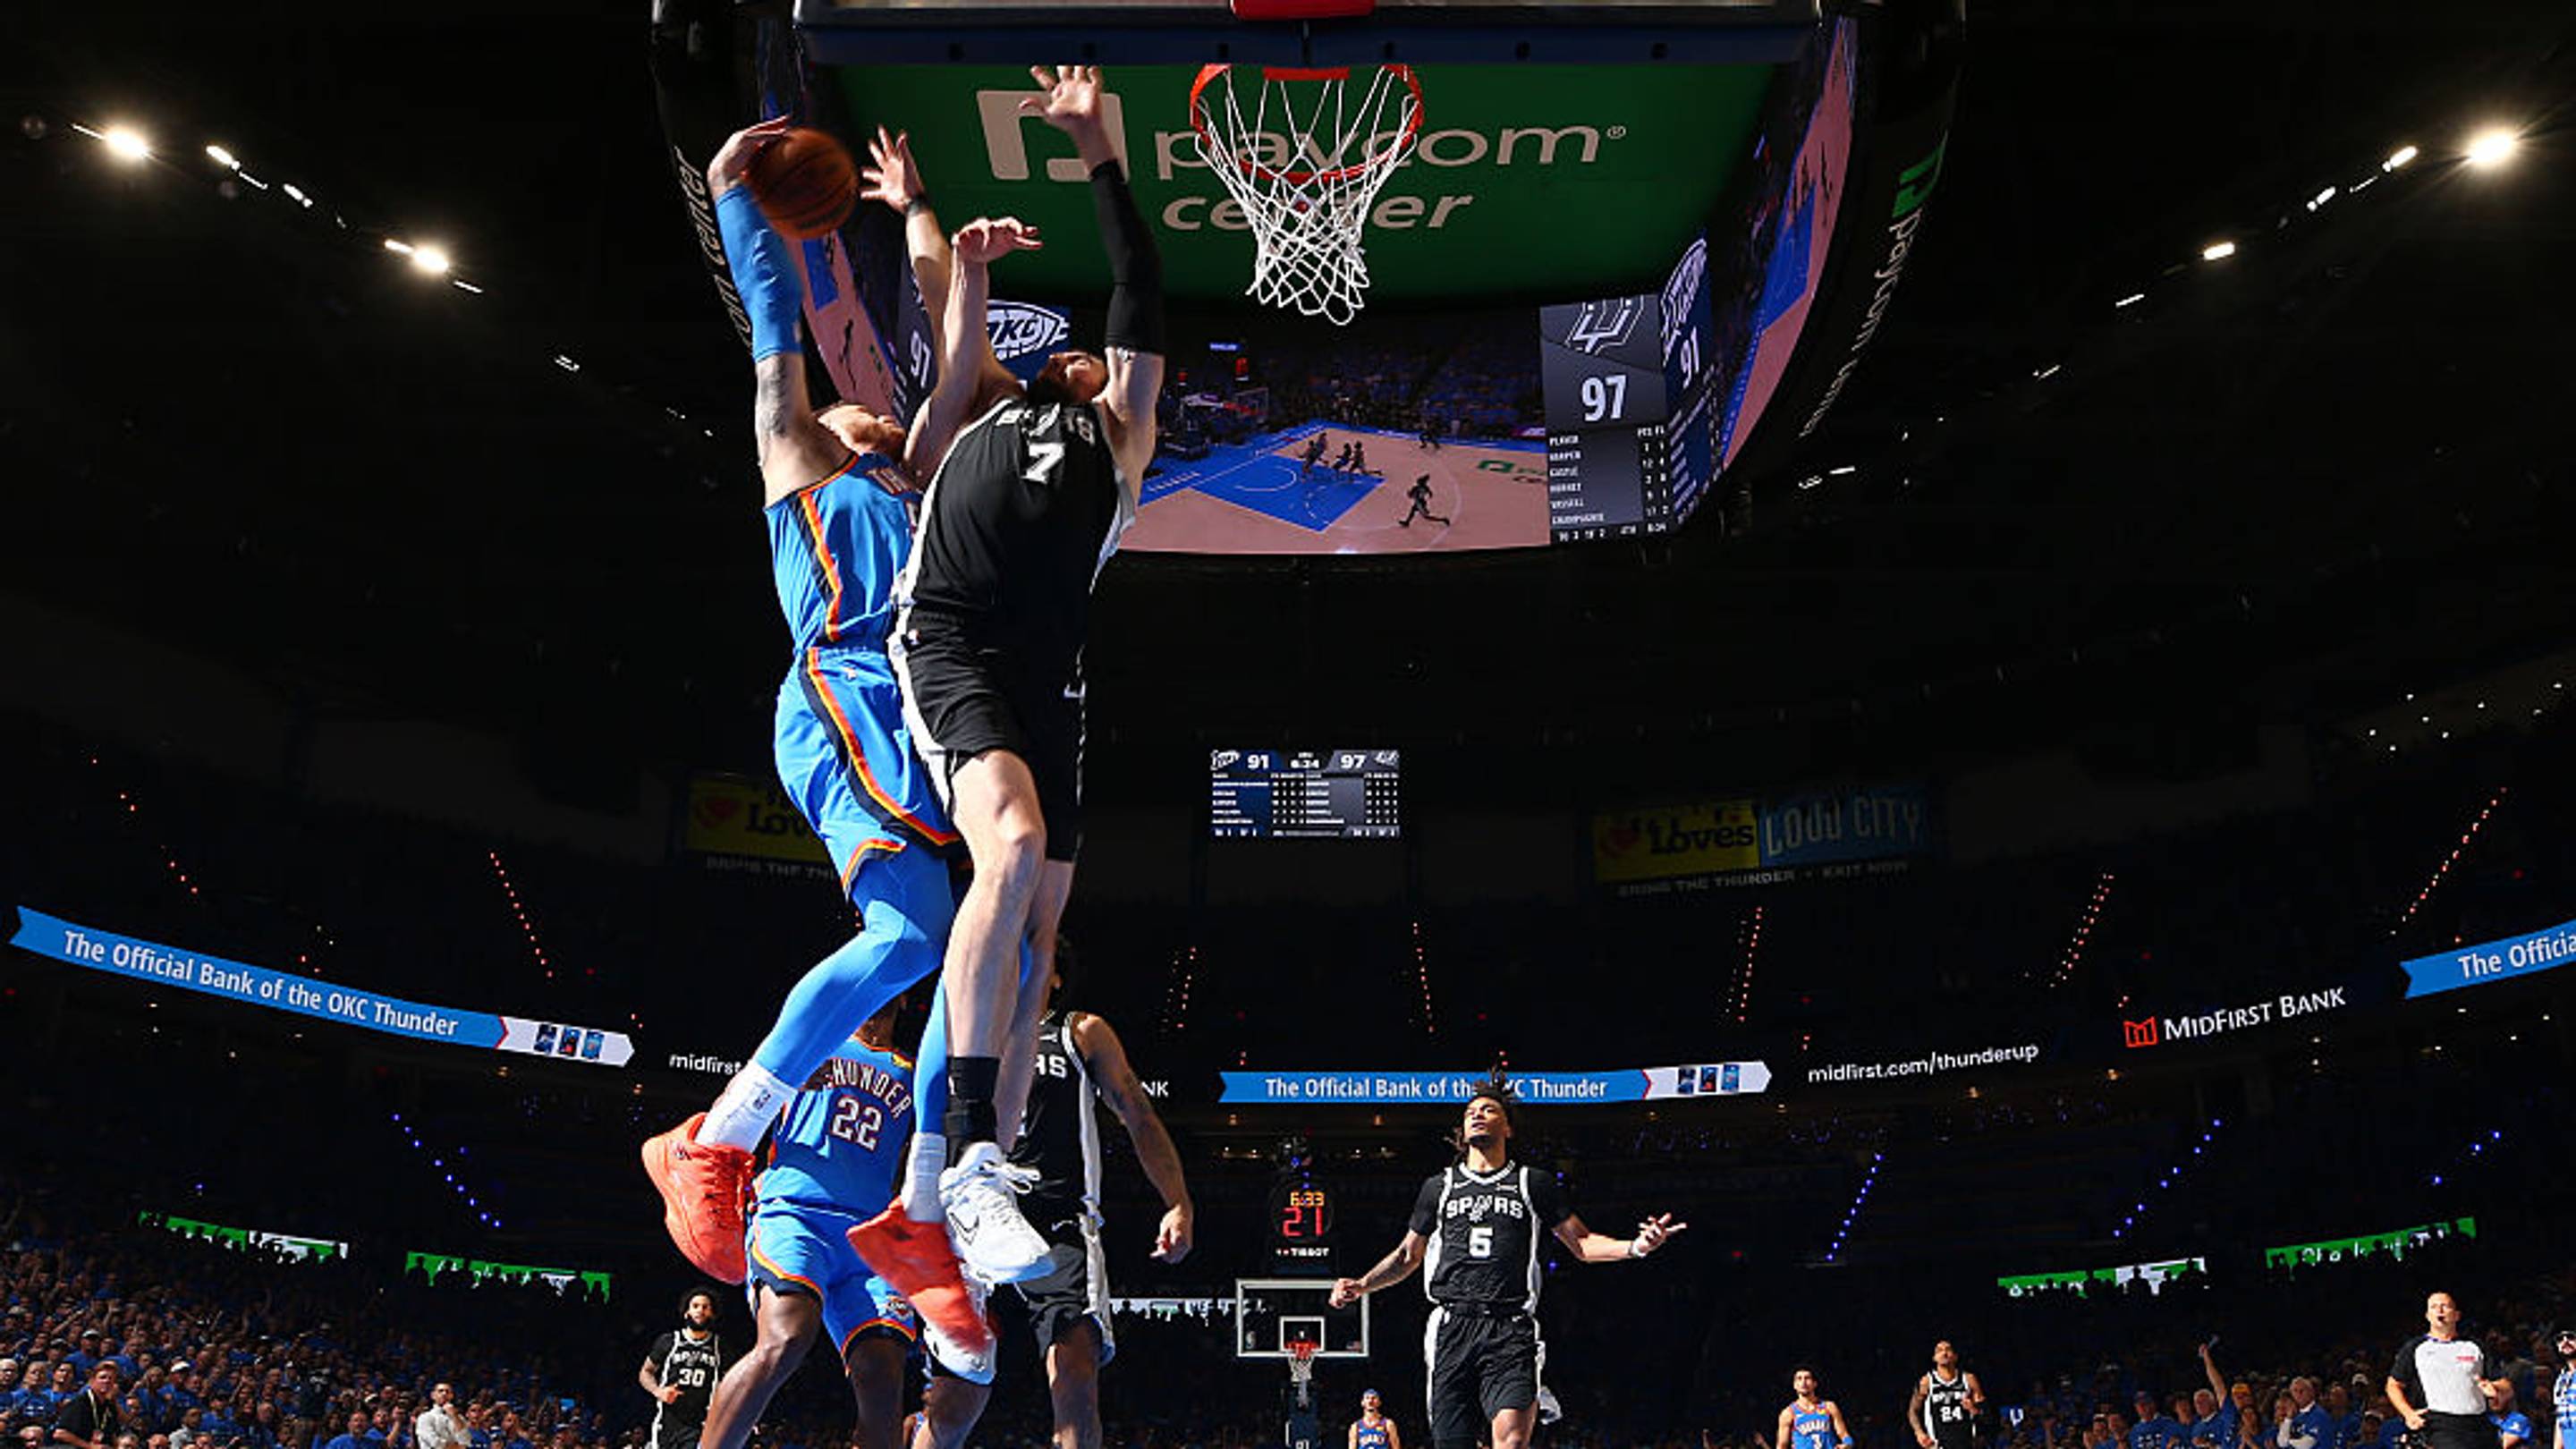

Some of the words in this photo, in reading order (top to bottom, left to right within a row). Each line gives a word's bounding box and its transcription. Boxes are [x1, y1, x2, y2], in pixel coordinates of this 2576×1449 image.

[1155, 124, 1601, 181] paycom
[911, 330, 932, 389] 97
[1679, 327, 1701, 389] 91
[1581, 374, 1627, 422] 97
[1021, 442, 1065, 484] 7
[1247, 754, 1269, 769] 91
[1341, 754, 1367, 769] 97
[1764, 798, 1843, 859] LOUD
[1850, 793, 1921, 845] CITY
[1715, 869, 1795, 888] THUNDER
[2457, 953, 2503, 980] The
[2508, 930, 2576, 968] Officia
[64, 930, 105, 962] The
[113, 942, 194, 982] Official
[199, 962, 254, 996] Bank
[259, 979, 284, 1001] of
[288, 985, 321, 1011] the
[327, 992, 369, 1021] OKC
[374, 1002, 459, 1037] Thunder
[2279, 986, 2347, 1019] BANK
[1808, 1043, 2040, 1084] midfirst.com/thunderup
[1266, 1078, 1299, 1097] The
[1305, 1077, 1371, 1097] Official
[1377, 1077, 1422, 1097] Bank
[1428, 1077, 1448, 1097] of
[1529, 1079, 1608, 1098] Thunder
[831, 1096, 883, 1151] 22
[1290, 1191, 1325, 1207] 6:33
[1446, 1195, 1523, 1223] SPURS
[1283, 1207, 1324, 1237] 21
[1469, 1226, 1494, 1258] 5
[678, 1368, 706, 1386] 30
[1940, 1406, 1963, 1422] 24
